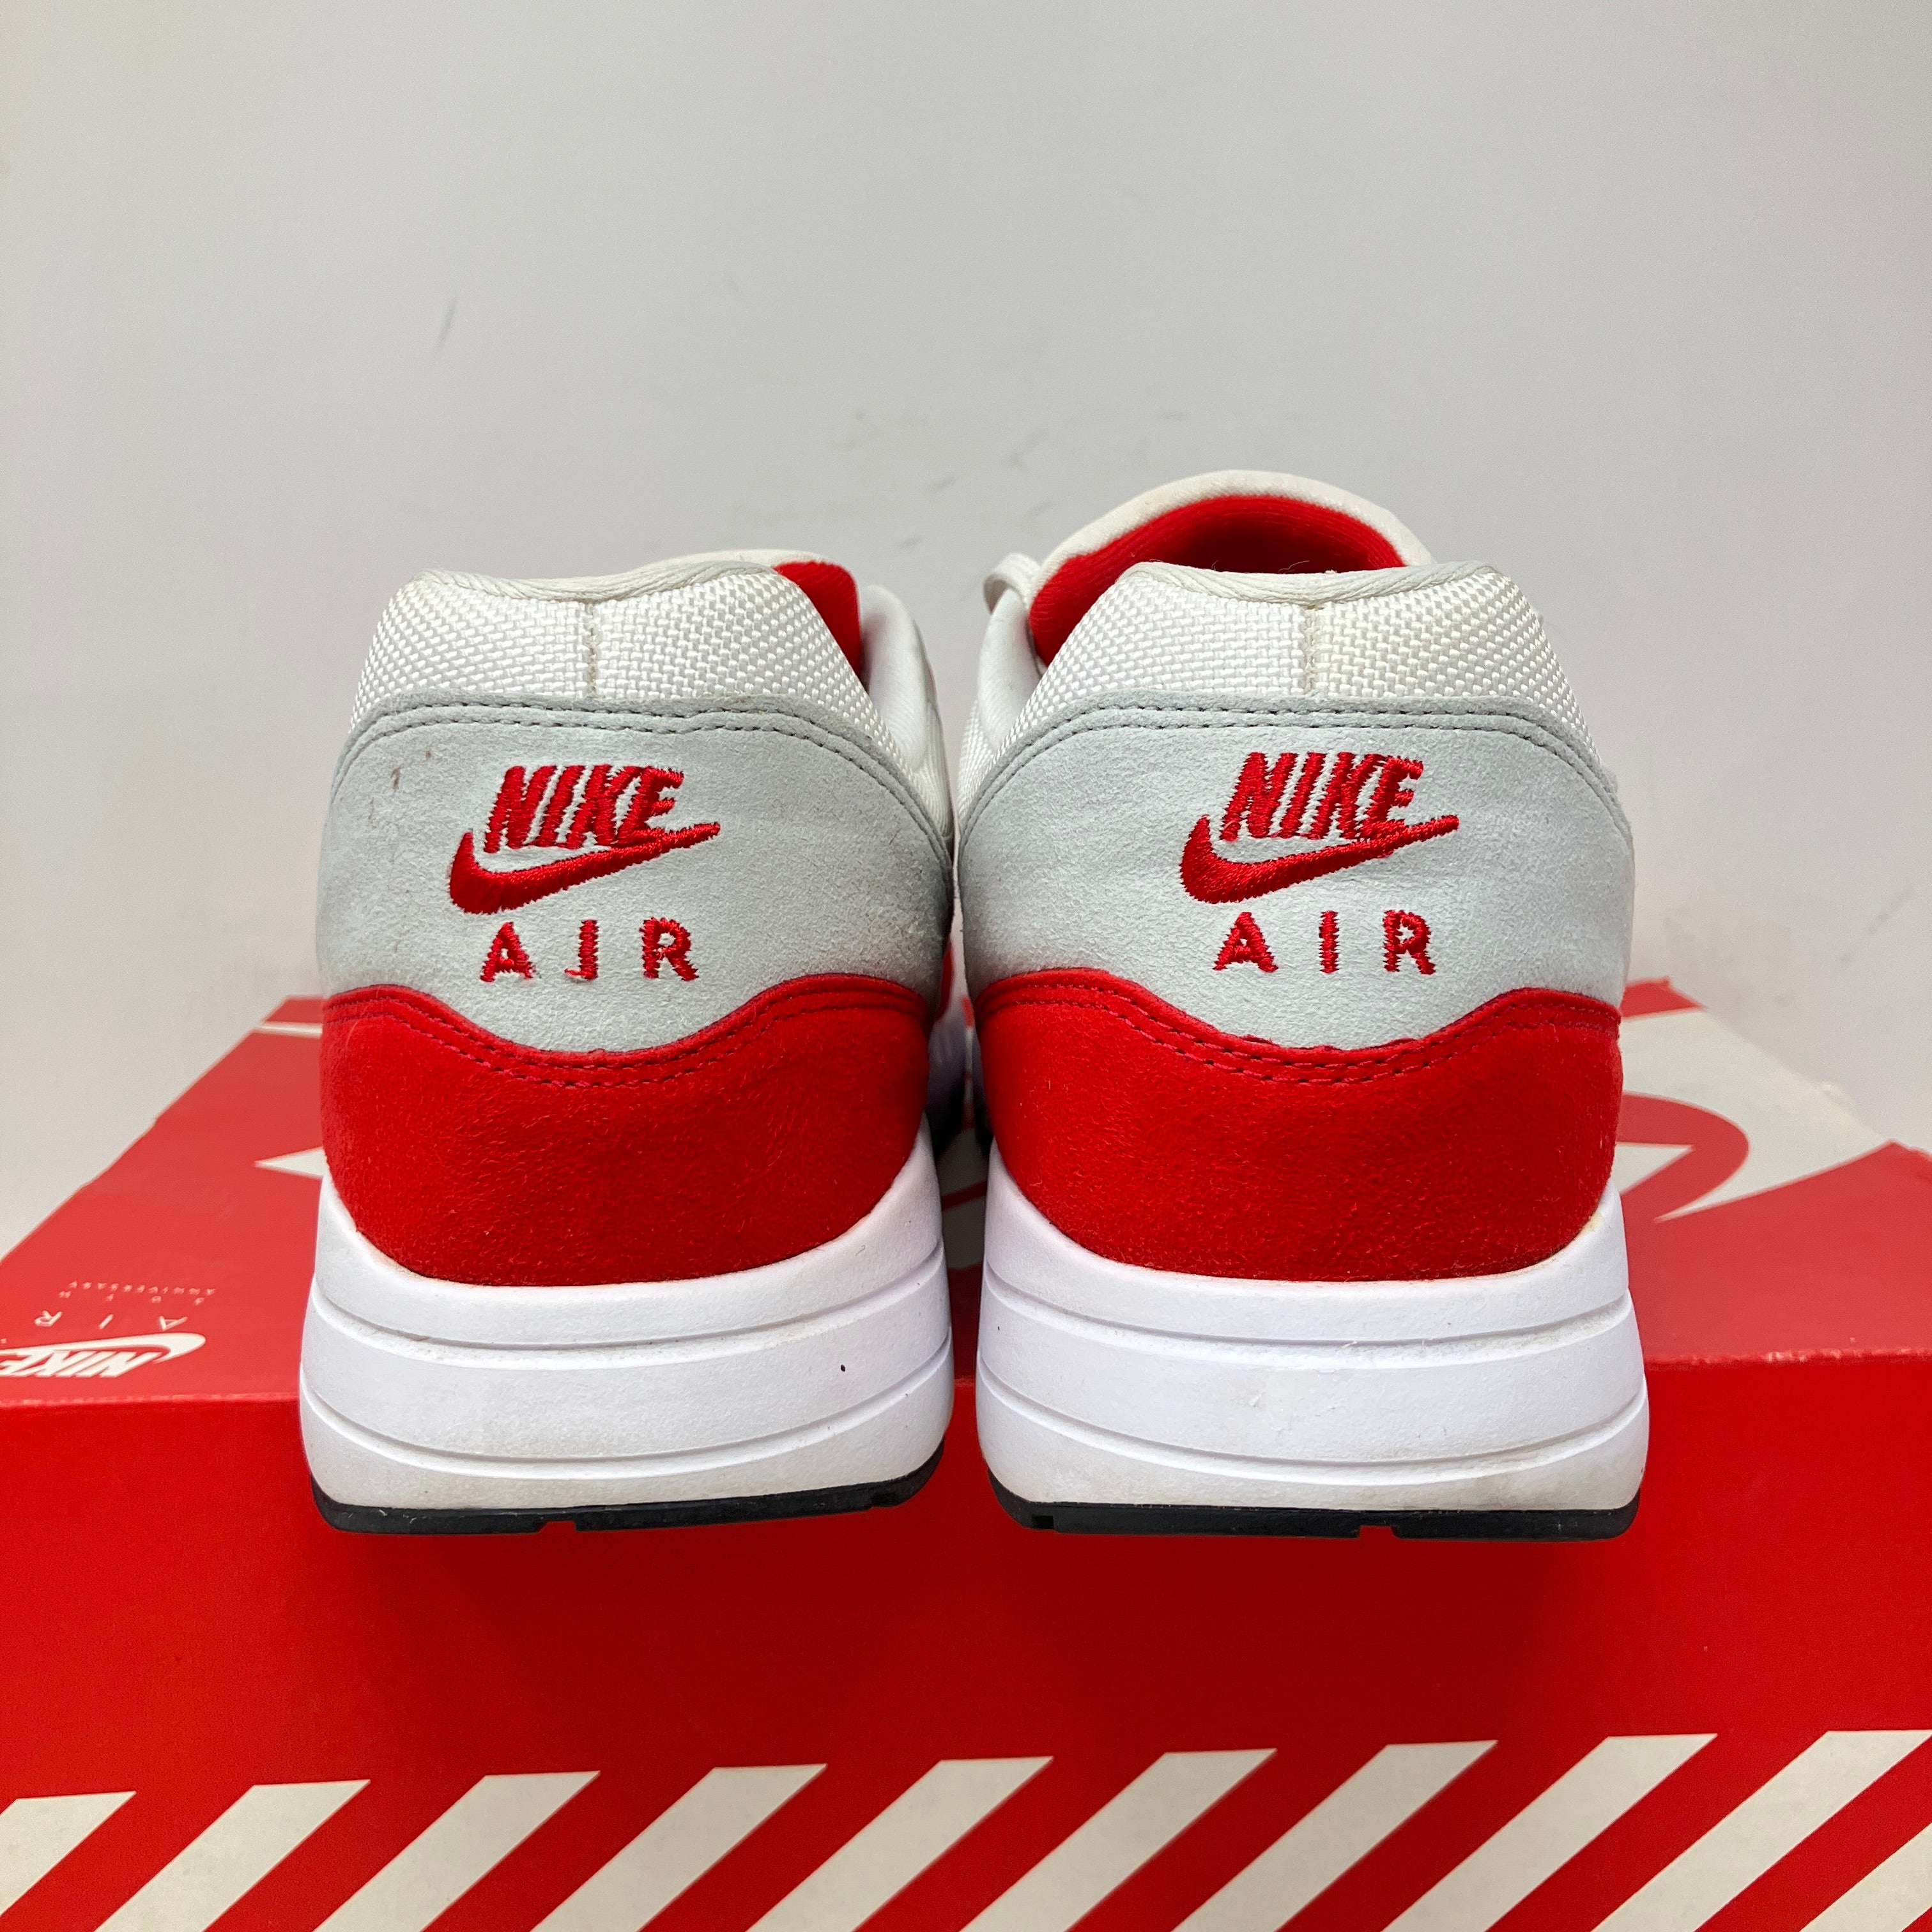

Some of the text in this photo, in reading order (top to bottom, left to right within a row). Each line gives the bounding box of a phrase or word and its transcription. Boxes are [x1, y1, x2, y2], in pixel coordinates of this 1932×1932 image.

[484, 765, 685, 853] NIKE
[1219, 751, 1424, 841] NIKE
[480, 917, 700, 982] AIR
[1213, 910, 1436, 974] AIR
[34, 1310, 188, 1331] AIR
[0, 1349, 162, 1378] NIKE
